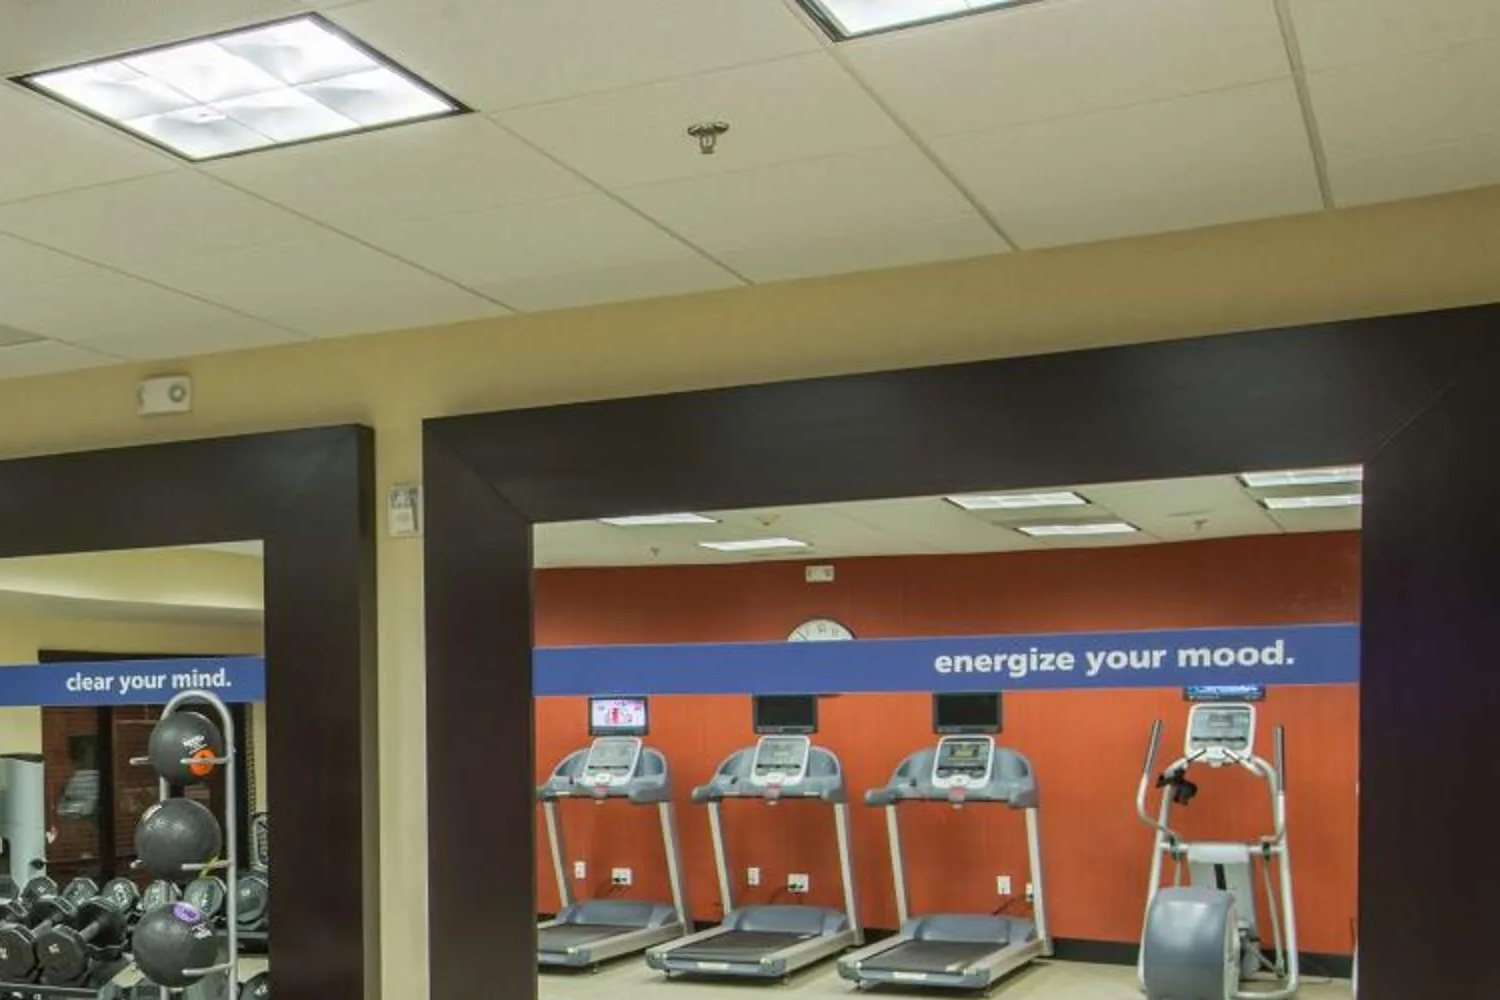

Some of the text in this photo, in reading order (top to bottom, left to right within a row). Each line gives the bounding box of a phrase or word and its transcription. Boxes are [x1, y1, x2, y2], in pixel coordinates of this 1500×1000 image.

[934, 639, 1296, 678] energize your mood.
[66, 667, 232, 695] clear your mind.
